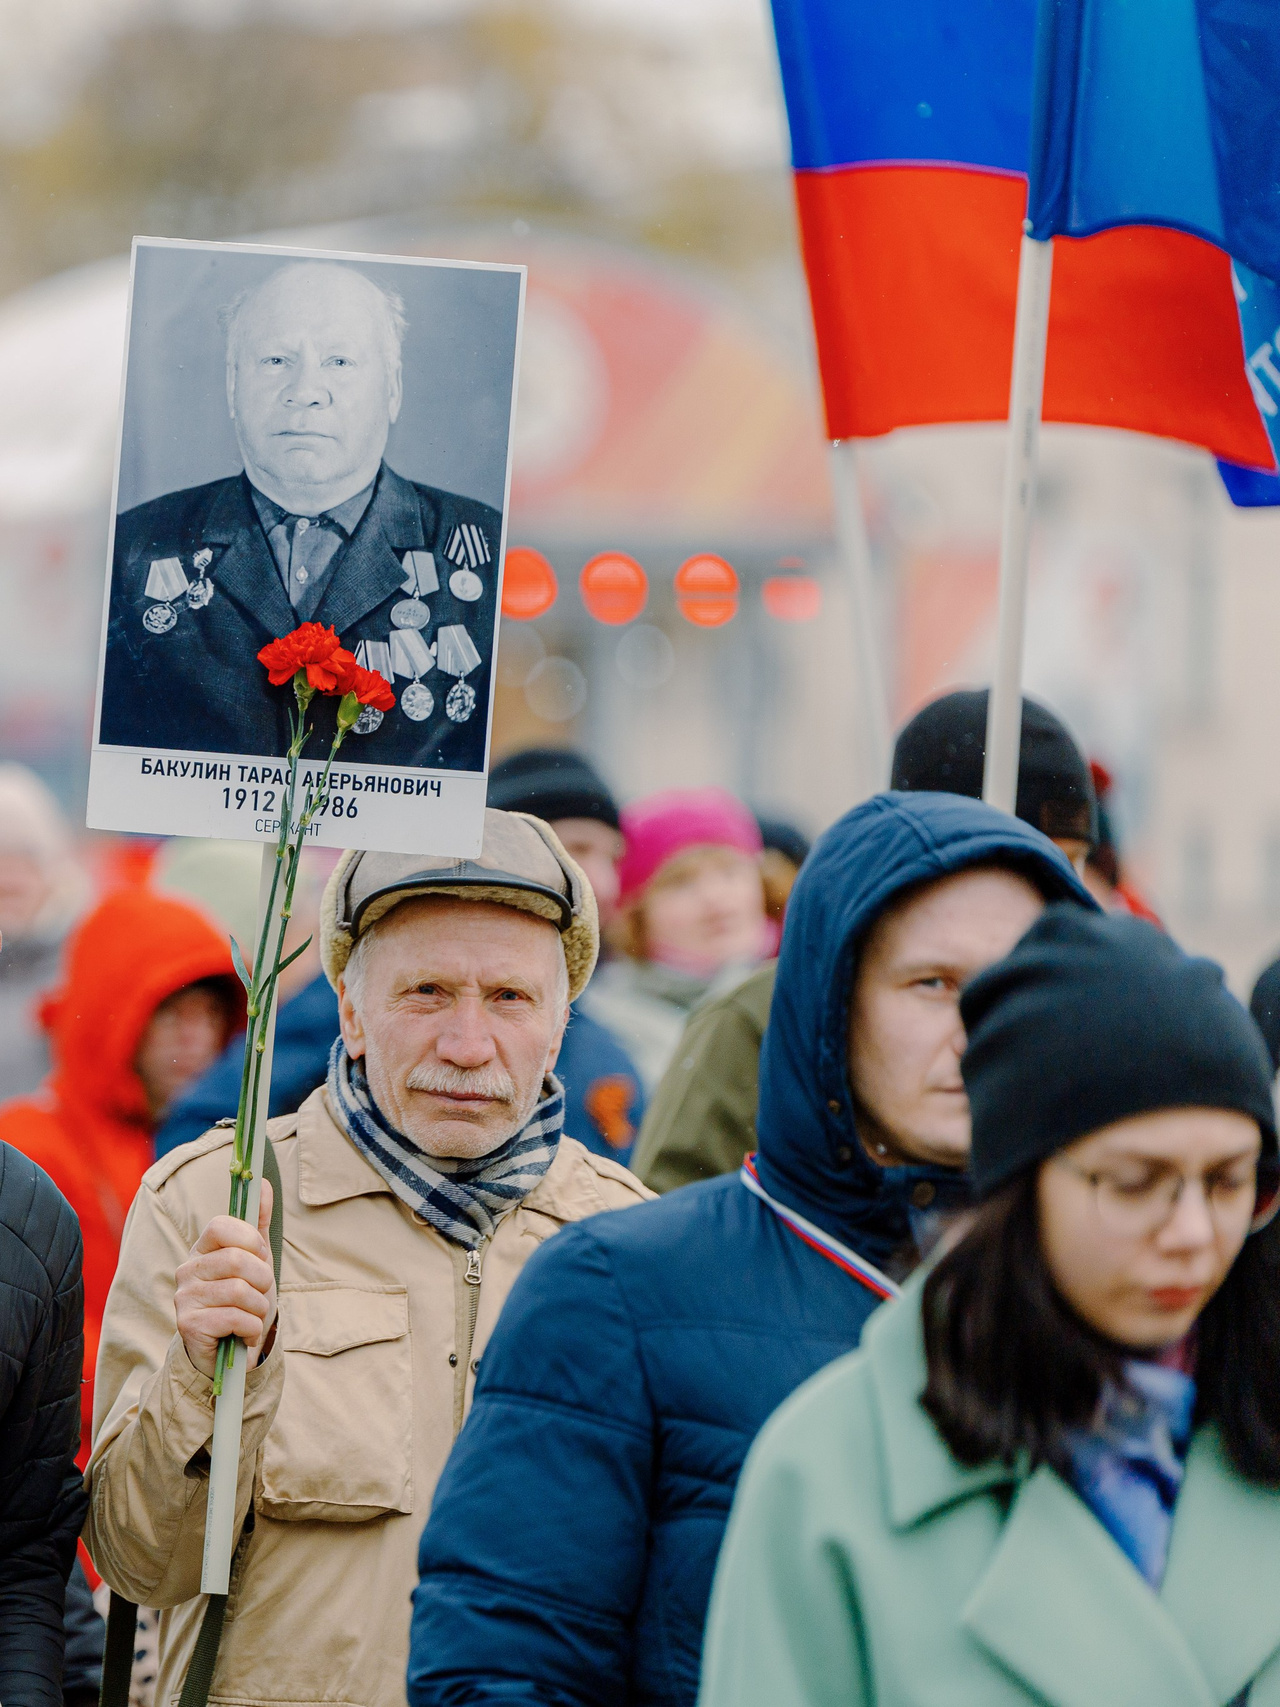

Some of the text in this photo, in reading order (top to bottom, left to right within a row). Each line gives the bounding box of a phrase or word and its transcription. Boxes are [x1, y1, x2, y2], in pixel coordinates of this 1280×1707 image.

[140, 757, 231, 781] БАКУЛИН
[301, 770, 441, 797] АВЕРЬЯНОВИЧ
[222, 787, 275, 812] 1912
